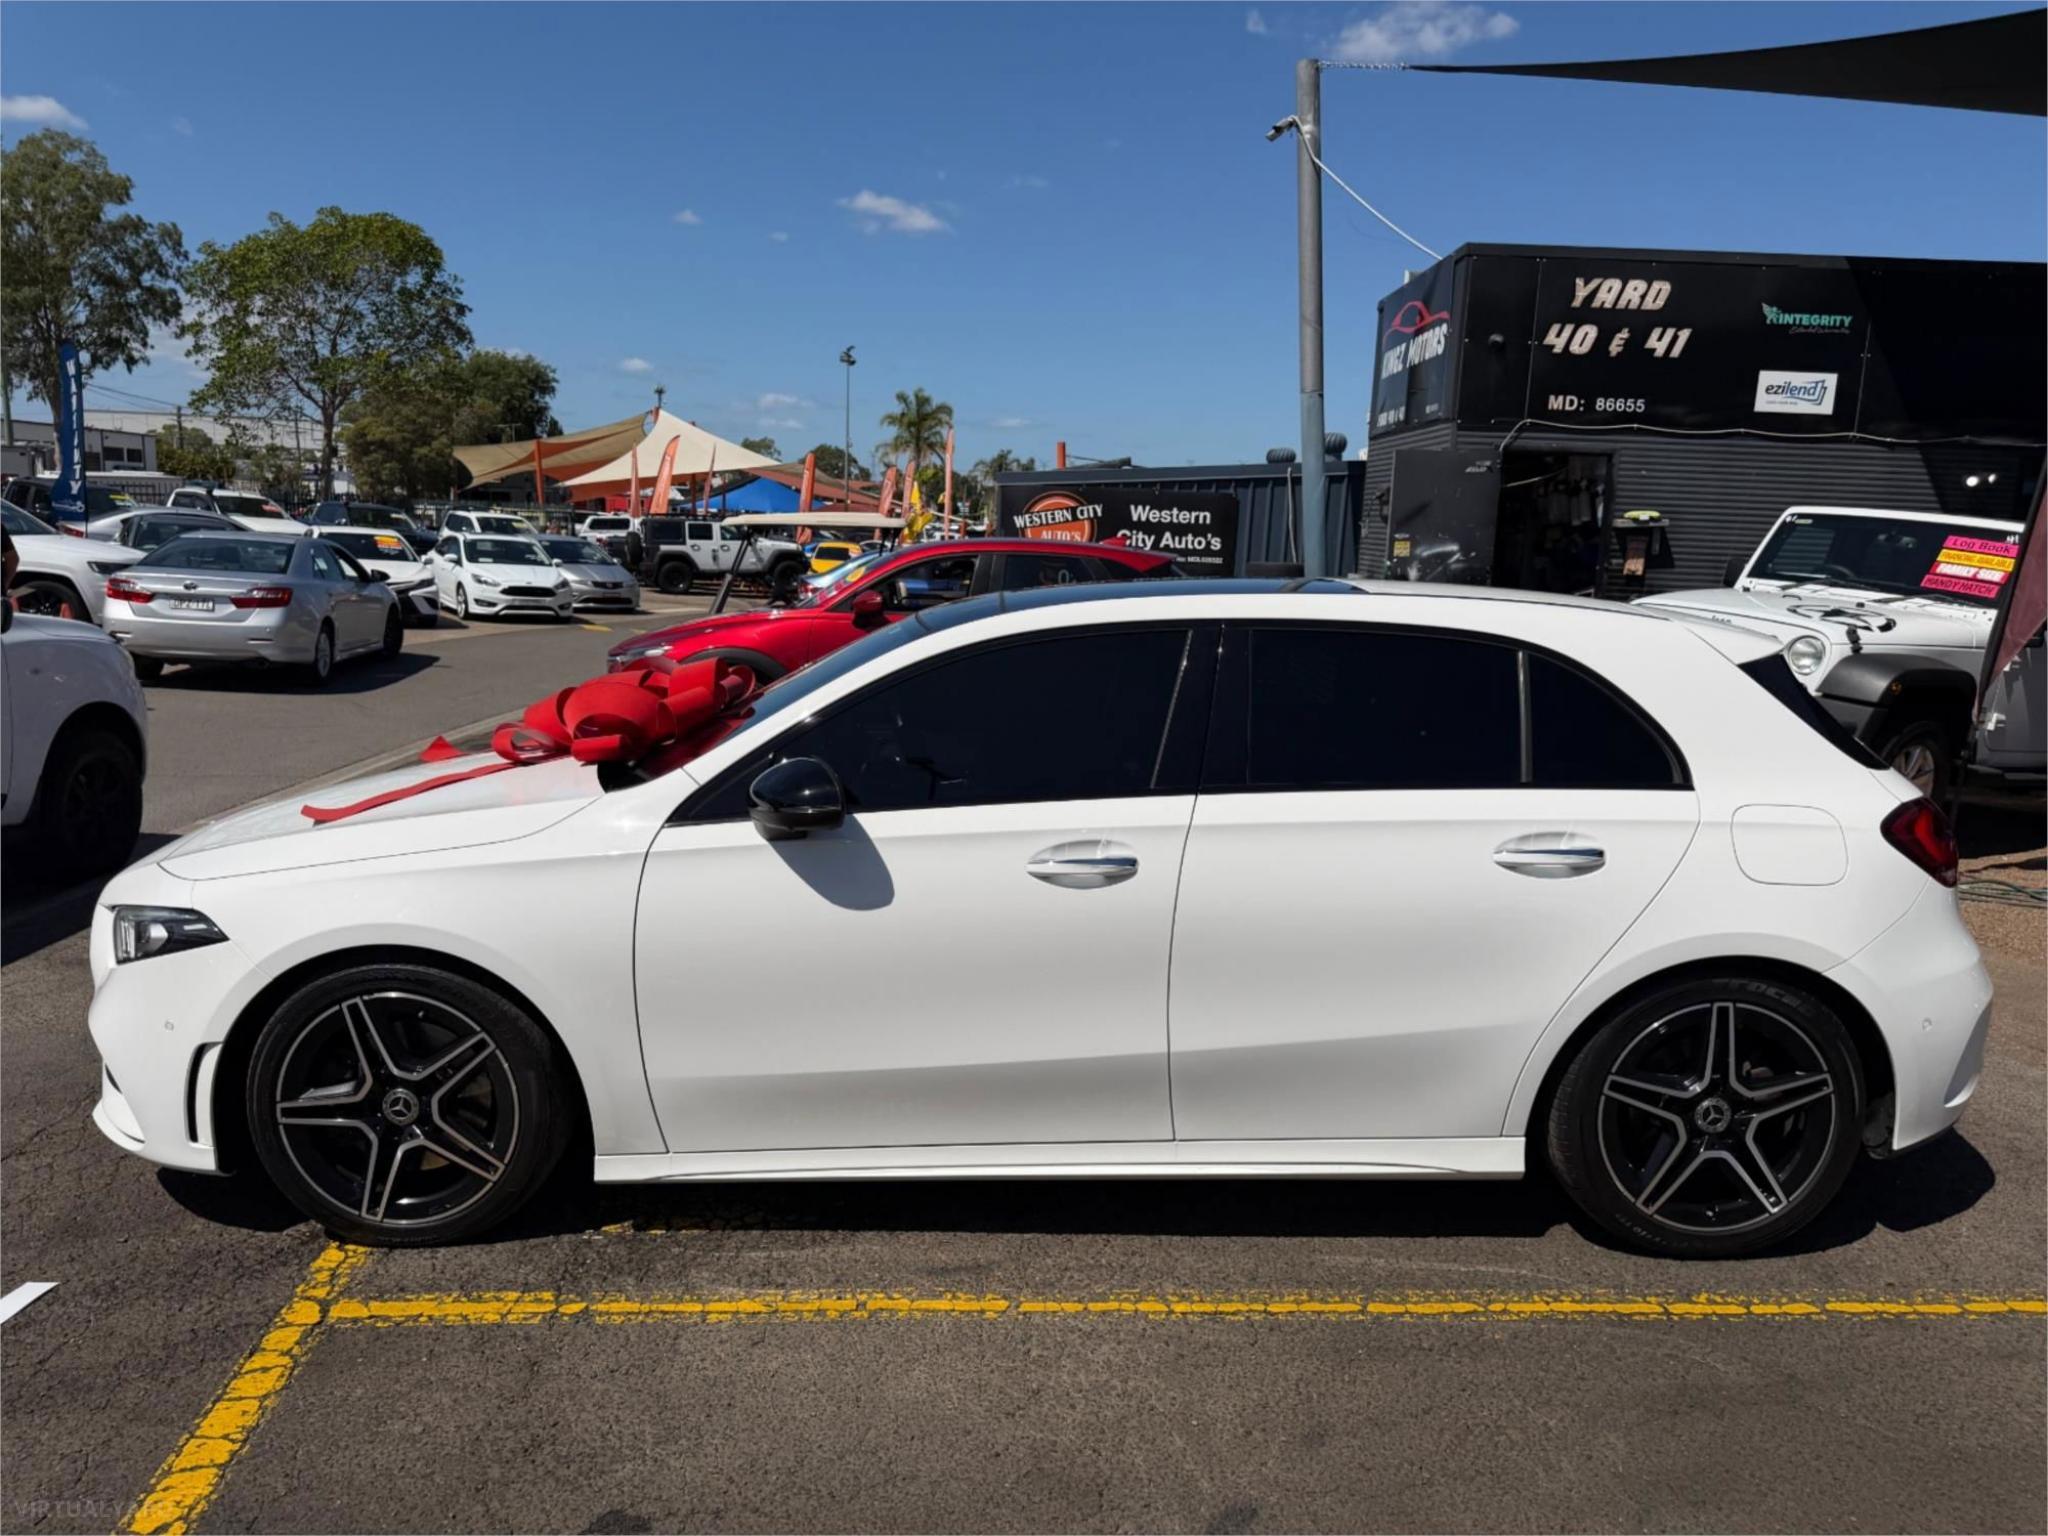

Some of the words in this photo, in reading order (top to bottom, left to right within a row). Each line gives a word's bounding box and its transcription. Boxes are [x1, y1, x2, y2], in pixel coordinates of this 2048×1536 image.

[1570, 277, 1672, 311] YARD
[1779, 312, 1853, 328] INTEGRITY
[1542, 323, 1599, 355] 40
[1644, 327, 1693, 358] 41
[1764, 380, 1819, 397] ezilend
[1548, 394, 1585, 412] MD:
[1595, 397, 1646, 413] 86655
[1013, 508, 1073, 529] WESTERN
[1076, 503, 1104, 519] CITY
[1130, 504, 1212, 525] Western
[1159, 531, 1222, 551] Auto's
[1953, 538, 1975, 550] Log
[1979, 540, 2011, 554] Book
